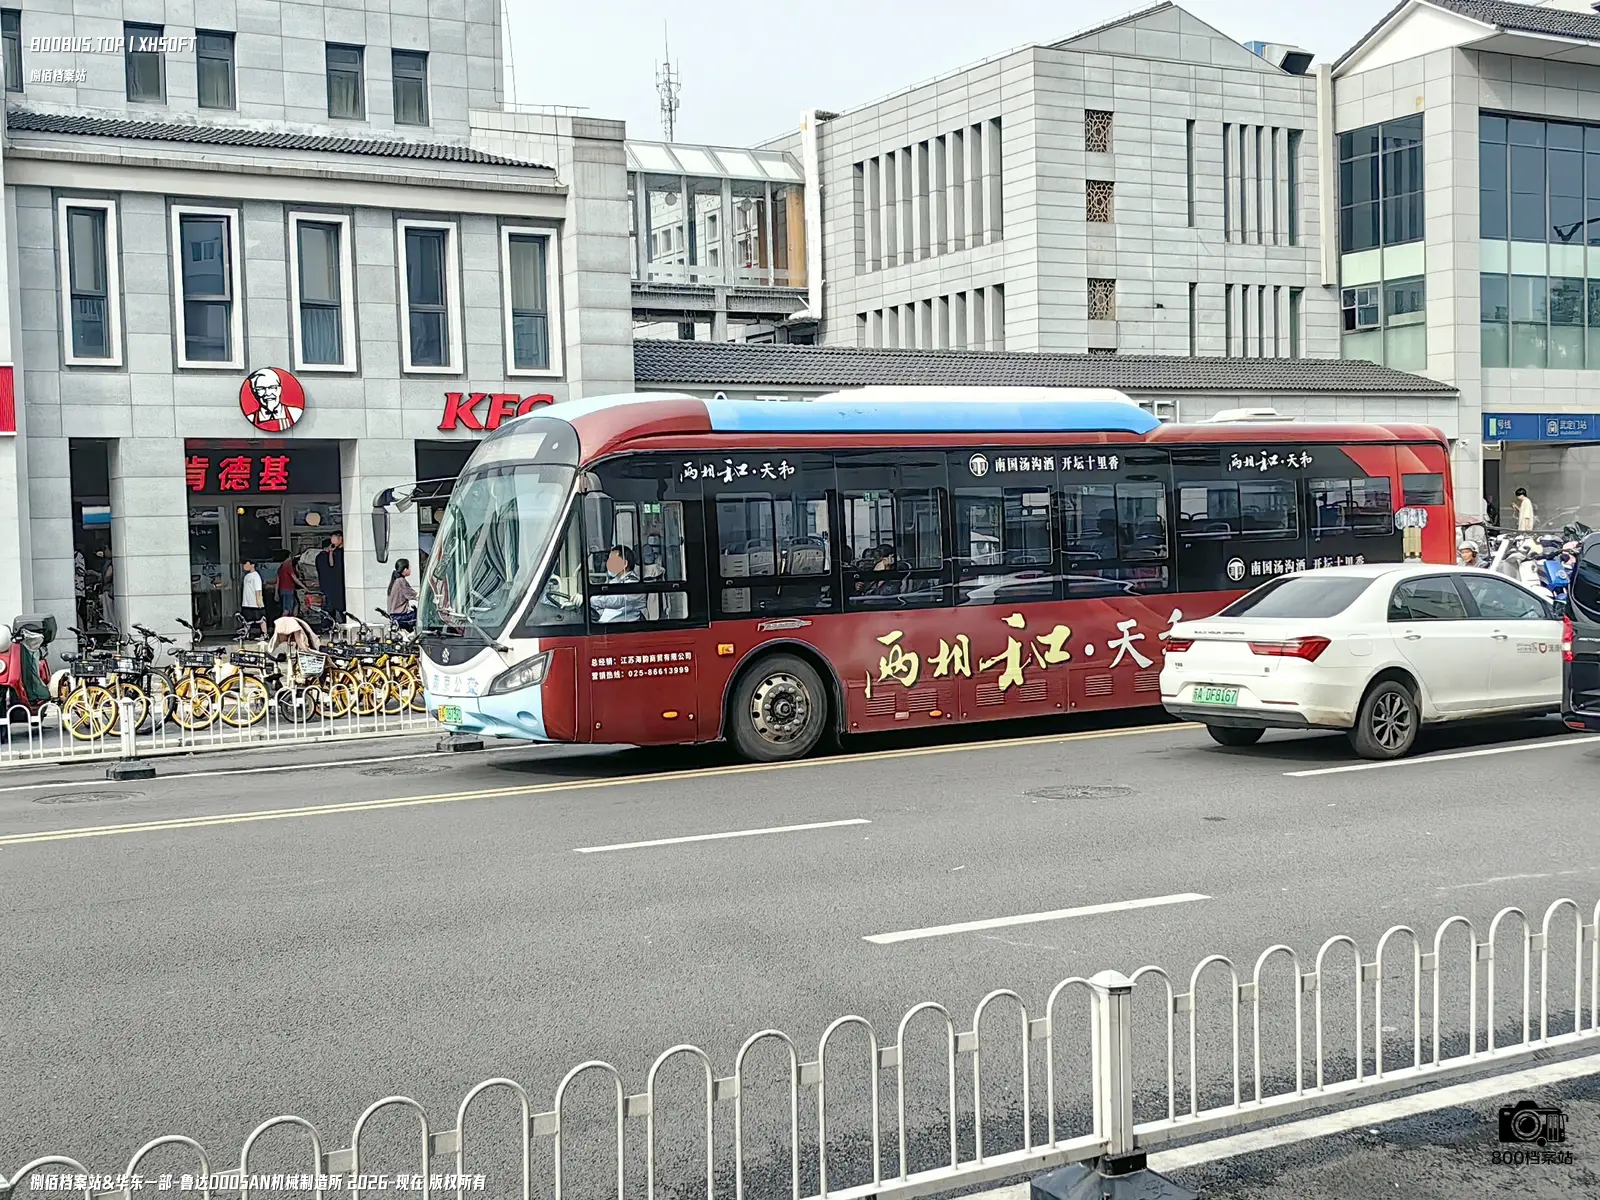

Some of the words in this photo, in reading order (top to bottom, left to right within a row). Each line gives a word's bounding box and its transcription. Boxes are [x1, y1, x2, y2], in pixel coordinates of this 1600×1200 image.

[185, 455, 290, 491] 肯德基
[994, 456, 1055, 472] 南国汤沟酒
[1061, 455, 1120, 471] 开坛十里香
